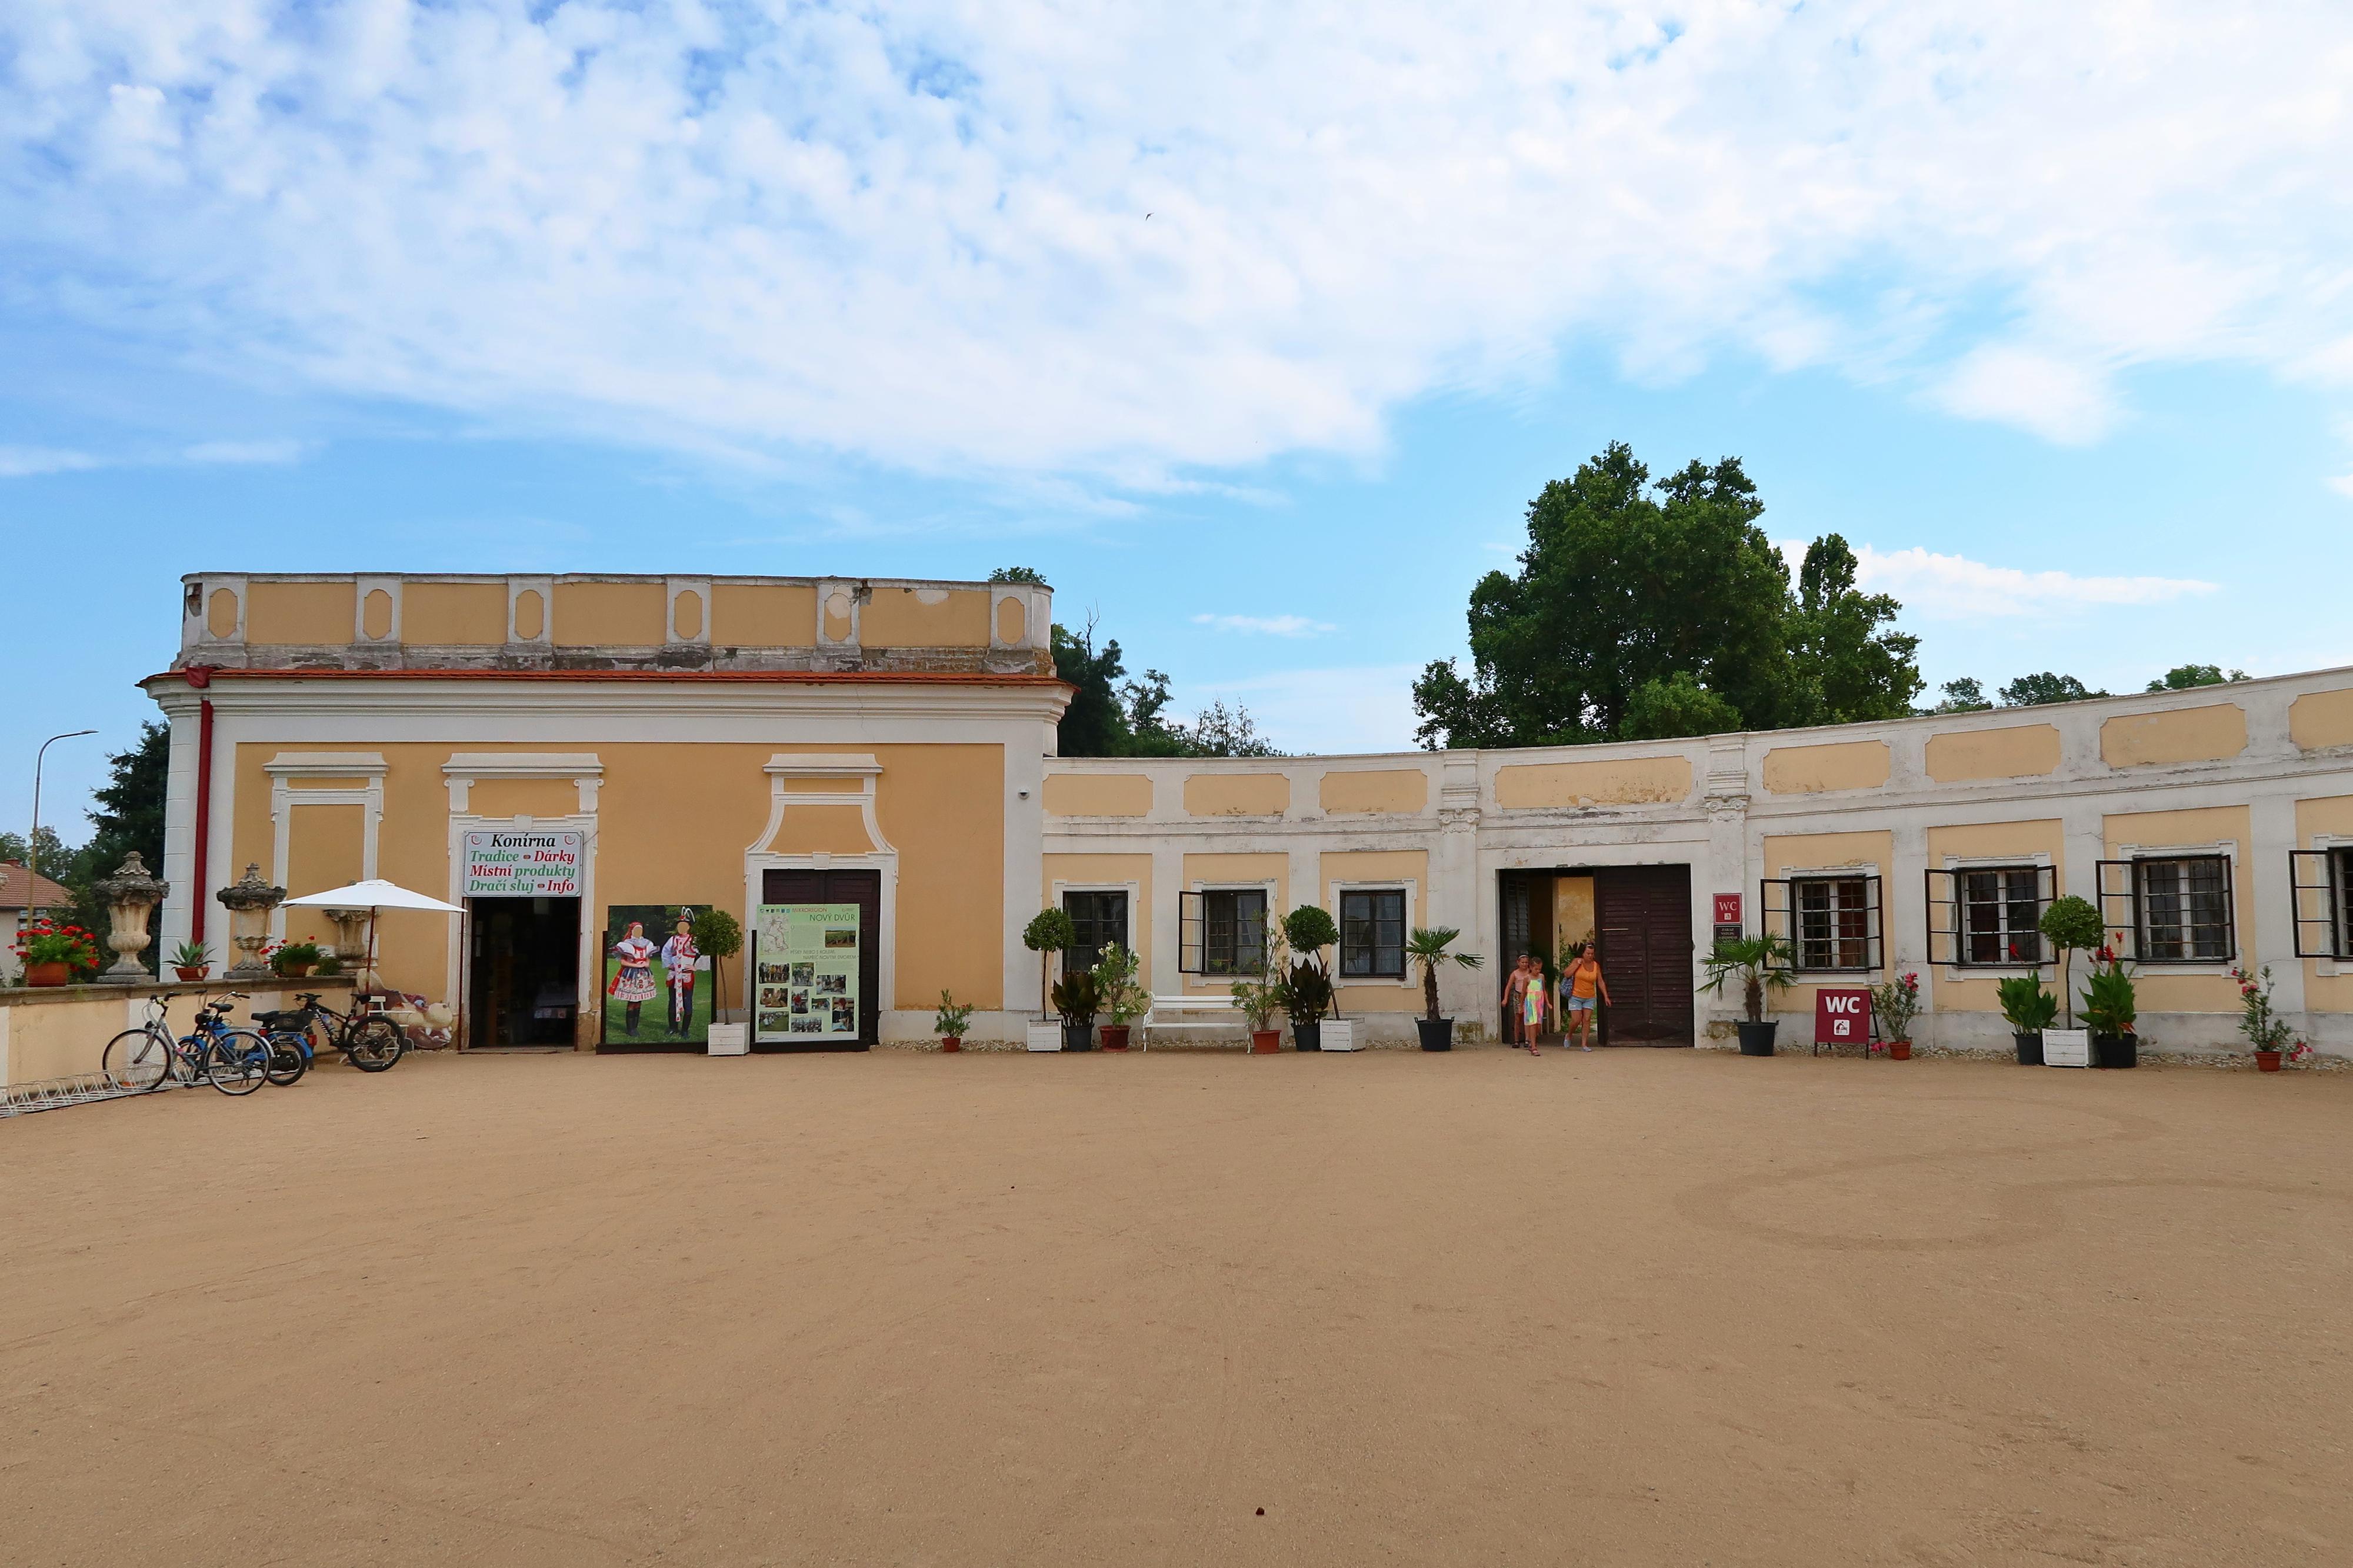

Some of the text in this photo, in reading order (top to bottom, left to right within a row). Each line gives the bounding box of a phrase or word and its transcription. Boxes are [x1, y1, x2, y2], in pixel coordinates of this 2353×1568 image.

[491, 833, 555, 847] Konírna
[471, 849, 575, 864] Tradice Dárky
[469, 865, 575, 879] Místní produkty
[469, 879, 574, 894] Dračí sluj Info
[1718, 902, 1737, 911] WC
[809, 913, 855, 921] NOVÝ DVŮR
[1825, 996, 1861, 1013] WC
